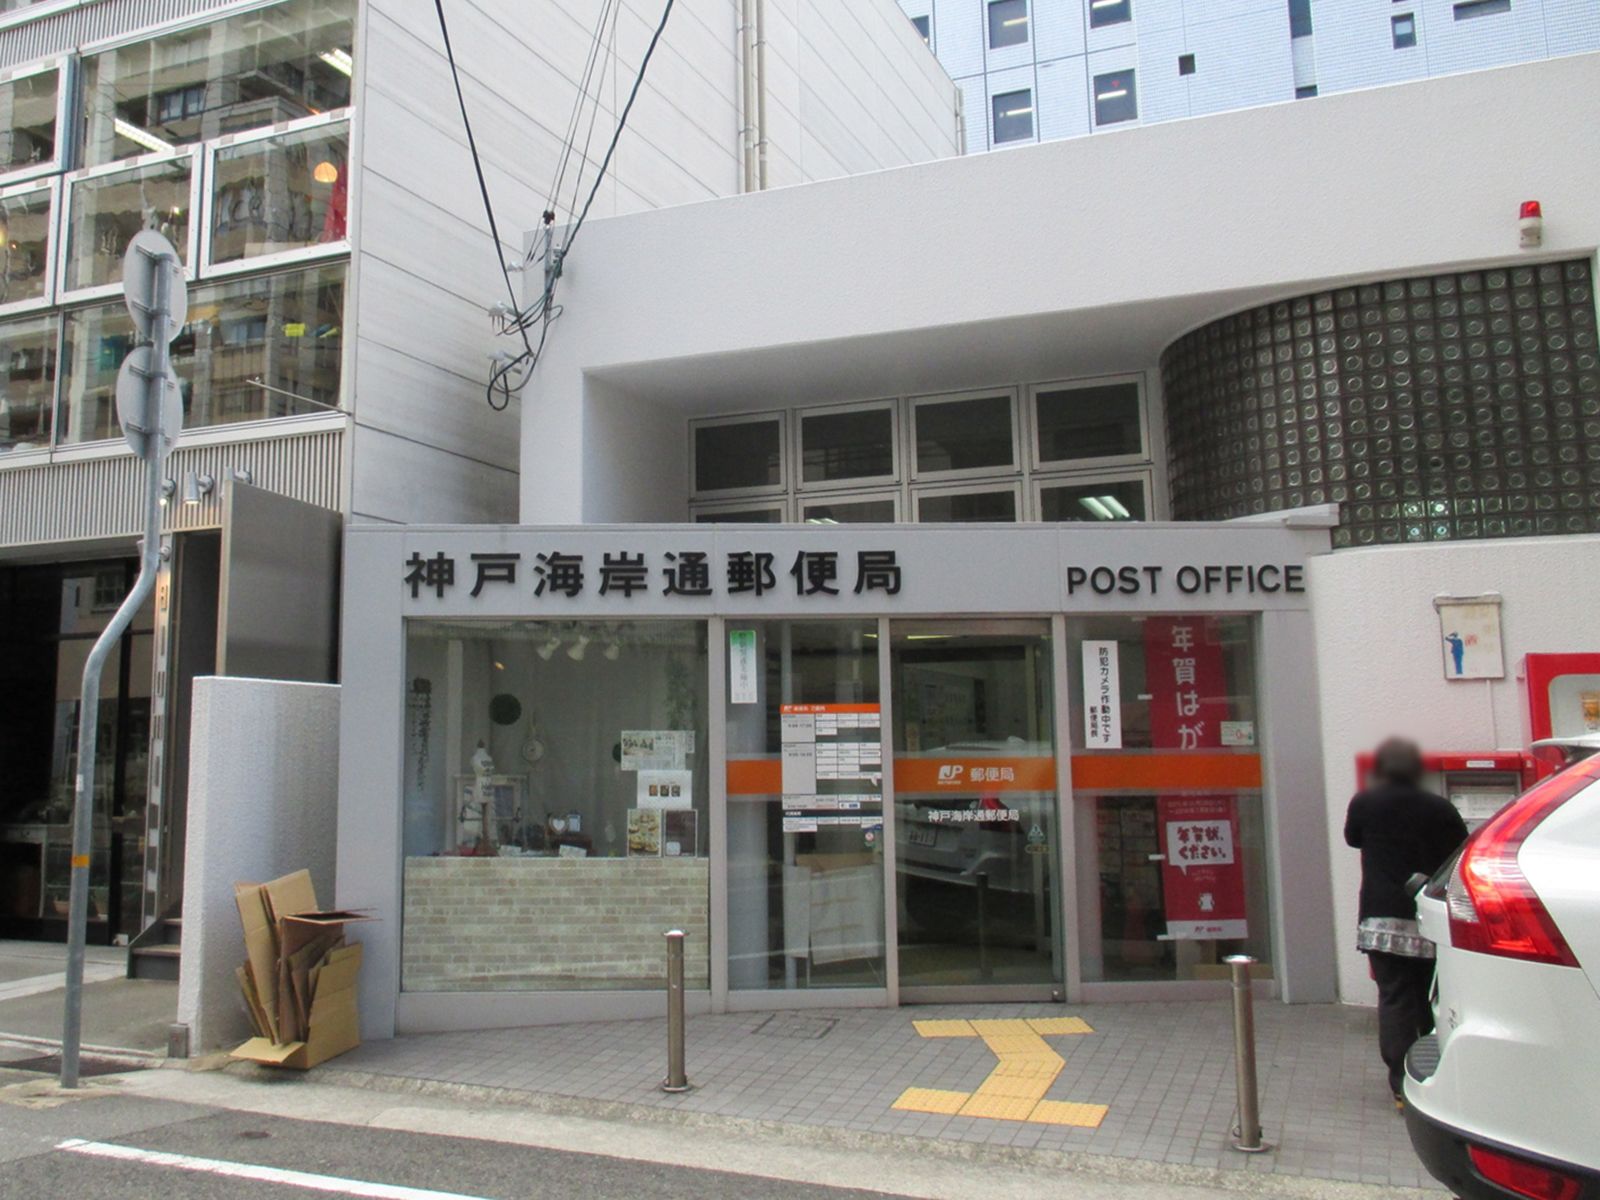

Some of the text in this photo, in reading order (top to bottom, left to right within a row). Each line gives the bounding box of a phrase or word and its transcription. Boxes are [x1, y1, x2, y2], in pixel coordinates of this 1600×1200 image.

[404, 550, 902, 598] 神戸海岸通郵便局
[1067, 564, 1306, 595] POST OFFICE
[1098, 646, 1112, 744] 防犯カメラ作動中です
